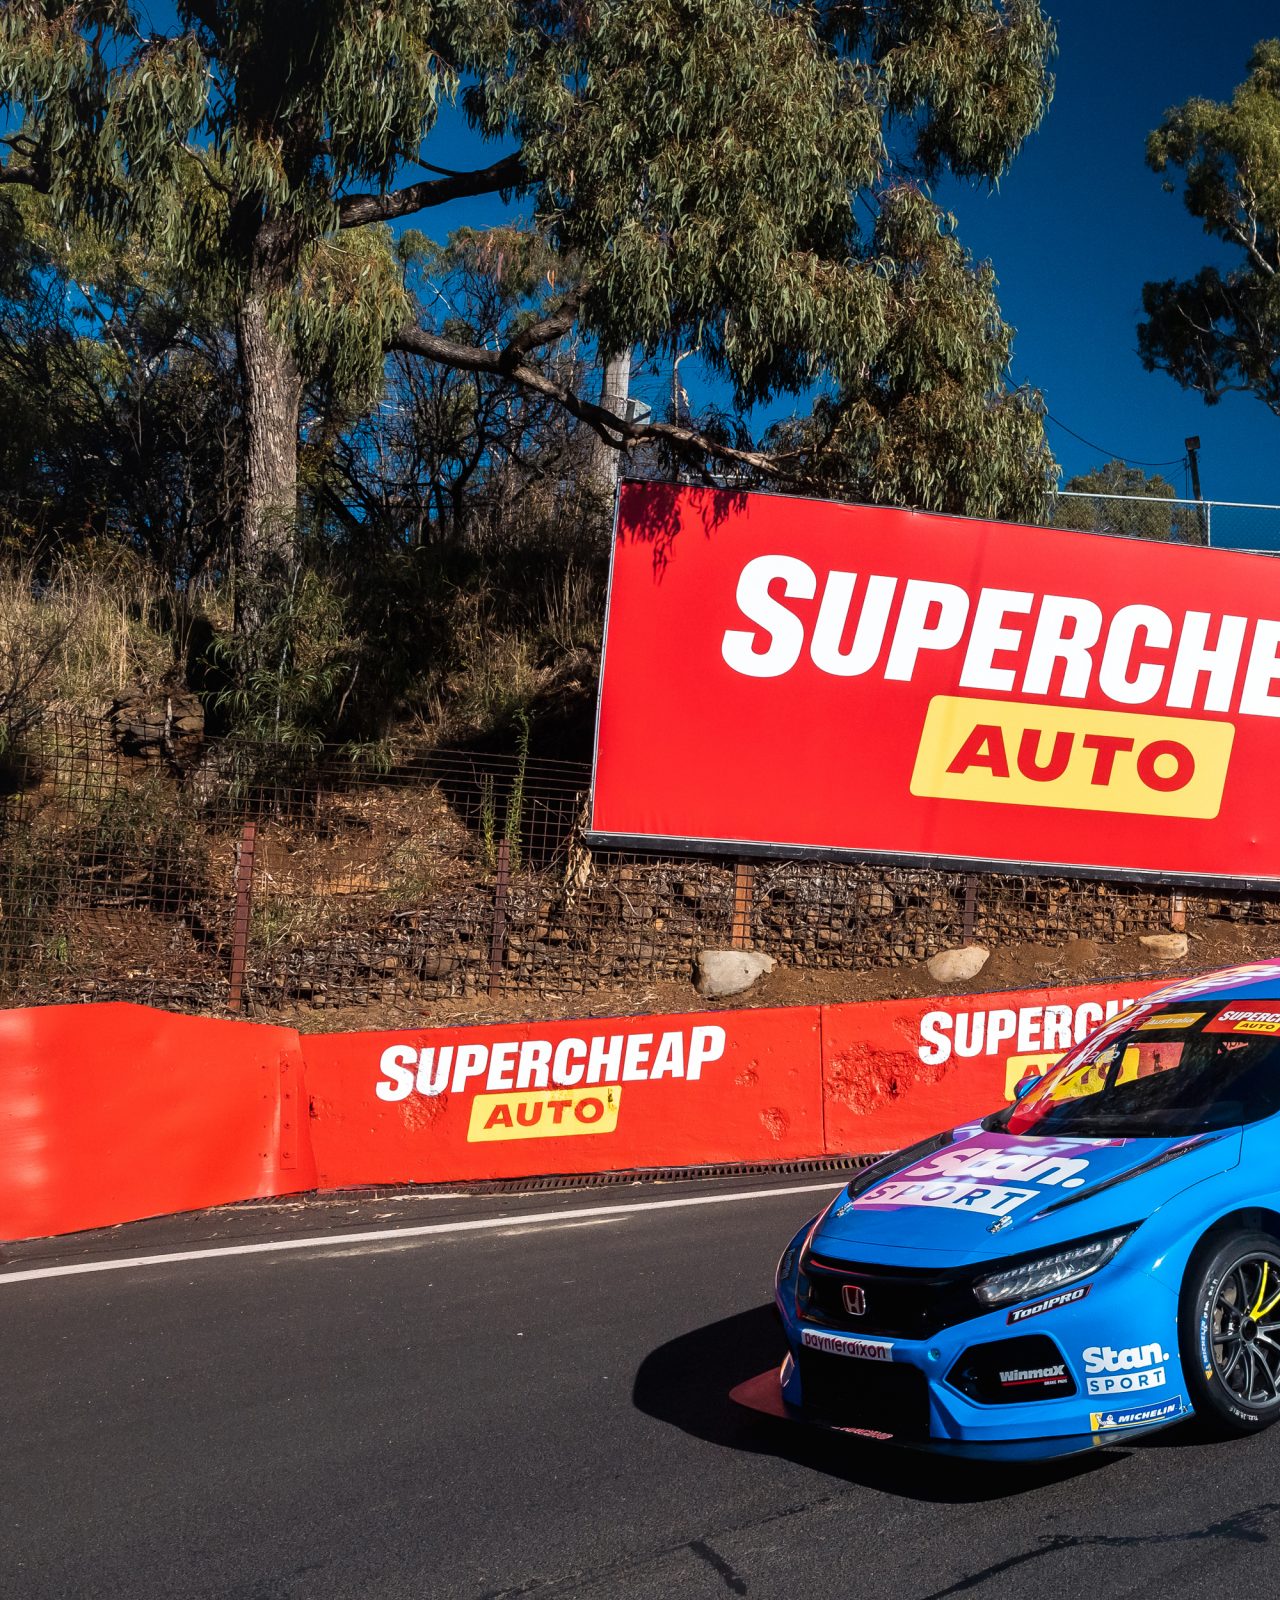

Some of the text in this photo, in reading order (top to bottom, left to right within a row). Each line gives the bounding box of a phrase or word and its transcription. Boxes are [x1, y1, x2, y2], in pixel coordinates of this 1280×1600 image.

[946, 724, 1195, 792] AUTO
[1239, 1022, 1276, 1031] AUTO
[376, 1025, 726, 1102] SUPERCHEAP
[484, 1097, 604, 1130] AUTO
[864, 1182, 1027, 1210] SPORT
[1012, 1288, 1085, 1321] ToolPRO
[1082, 1342, 1170, 1374] Stan.
[1089, 1370, 1162, 1392] SPORT
[1118, 1403, 1176, 1423] MICHELIN
